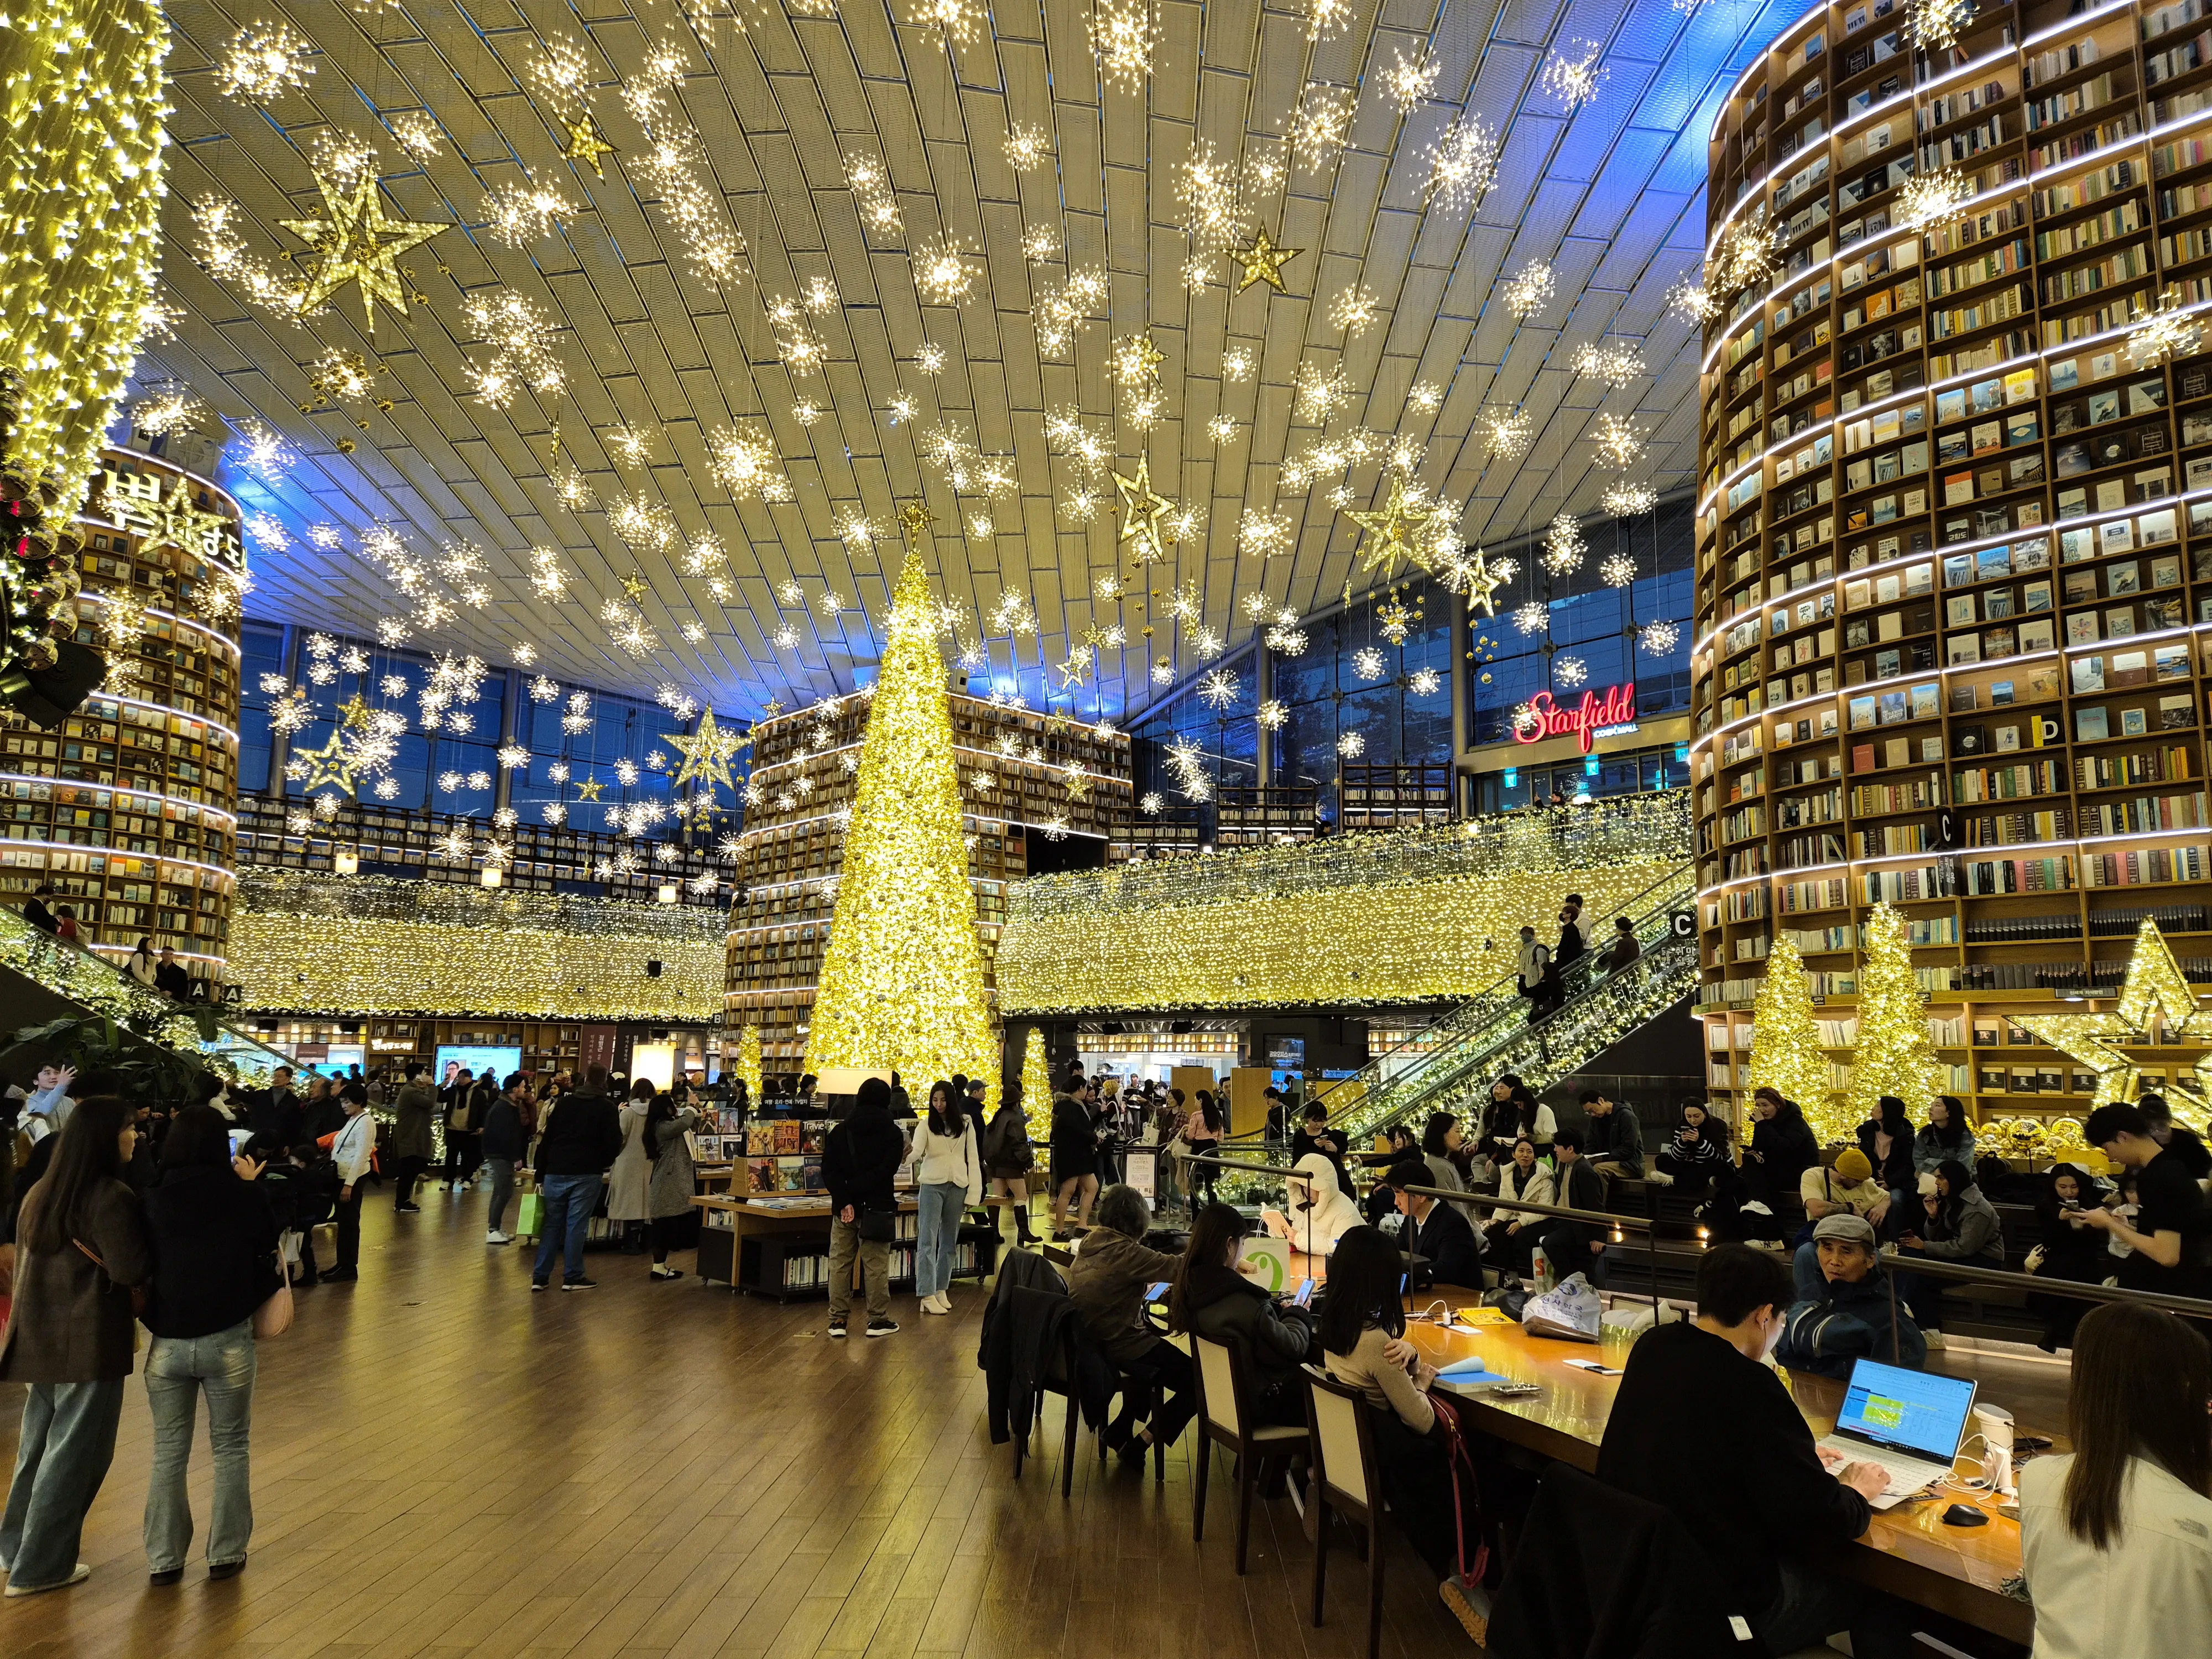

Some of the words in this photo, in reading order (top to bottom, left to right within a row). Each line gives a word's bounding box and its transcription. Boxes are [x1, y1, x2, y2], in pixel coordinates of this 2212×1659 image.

[1515, 682, 1635, 753] Starfield
[2042, 721, 2058, 740] D
[1942, 815, 1951, 842] C
[1674, 915, 1692, 935] C
[192, 983, 204, 996] A
[226, 988, 238, 1000] A
[714, 1014, 721, 1024] B
[802, 1121, 825, 1130] Travie
